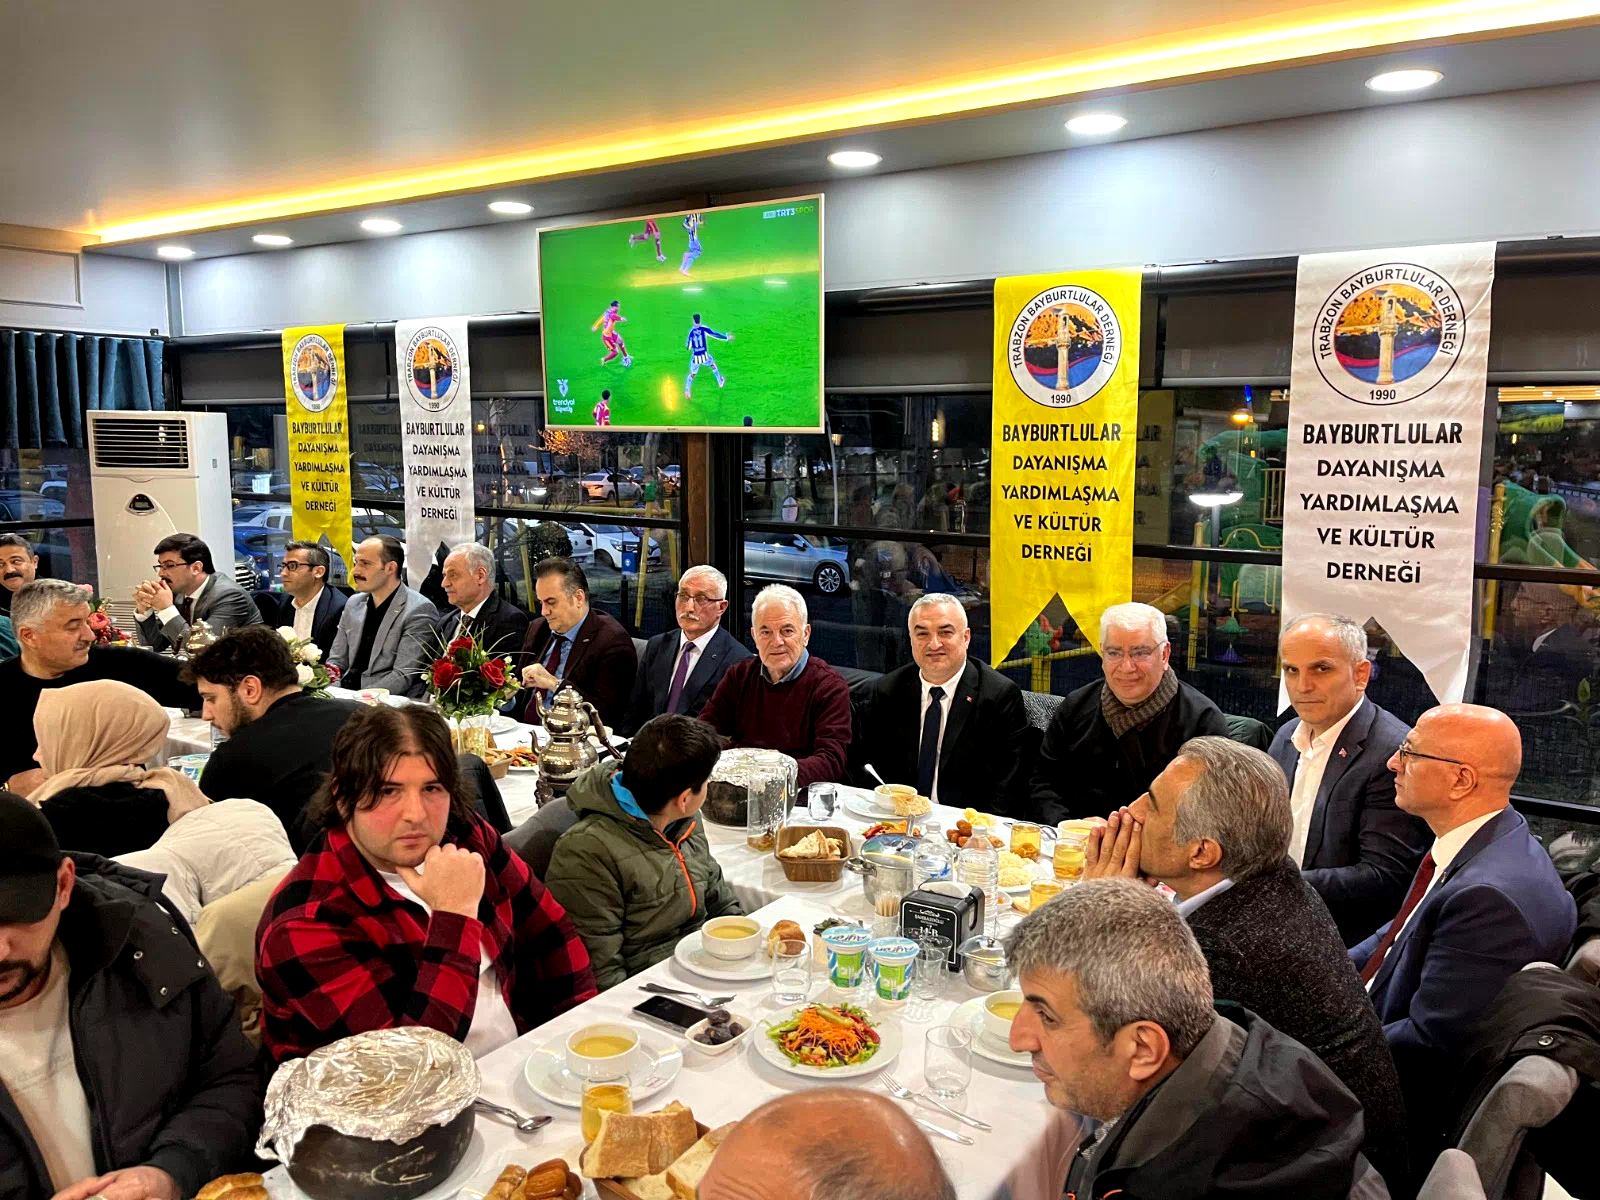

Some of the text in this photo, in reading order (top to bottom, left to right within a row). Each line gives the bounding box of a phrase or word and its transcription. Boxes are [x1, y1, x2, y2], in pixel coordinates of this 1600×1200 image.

[1319, 268, 1458, 360] TRABZON BAYBURTLULAR DERNEĞİ
[1013, 289, 1116, 369] TRABZON BAYBURTLULAR DERNEĞİ
[1050, 394, 1072, 404] 1990
[1369, 389, 1397, 401] 1990
[292, 422, 343, 435] BAYBURTLULAR
[406, 422, 465, 436] BAYBURTLULAR
[1003, 423, 1121, 442] BAYBURTLULAR
[1303, 422, 1463, 444] BAYBURTLULAR
[298, 442, 339, 456] DAYANIŞMA
[412, 444, 460, 459] DAYANIŞMA
[294, 461, 345, 475] YARDIMLAŞMA
[408, 465, 467, 480] YARDIMLAŞMA
[1013, 455, 1108, 475] DAYANIŞMA
[1317, 459, 1445, 482] DAYANIŞMA
[301, 479, 339, 492] VE KÜLTÜR
[416, 484, 461, 499] VE KÜLTÜR
[1002, 484, 1120, 505] YARDIMLAŞMA
[305, 499, 336, 512] DERNEĞİ
[421, 506, 457, 520] DERNEĞİ
[1300, 493, 1459, 518] YARDIMLAŞMA
[1014, 512, 1102, 532] VE KÜLTÜR
[1317, 525, 1435, 549] VE KÜLTÜR
[1021, 542, 1092, 562] DERNEĞİ
[1327, 561, 1421, 583] DERNEĞİ
